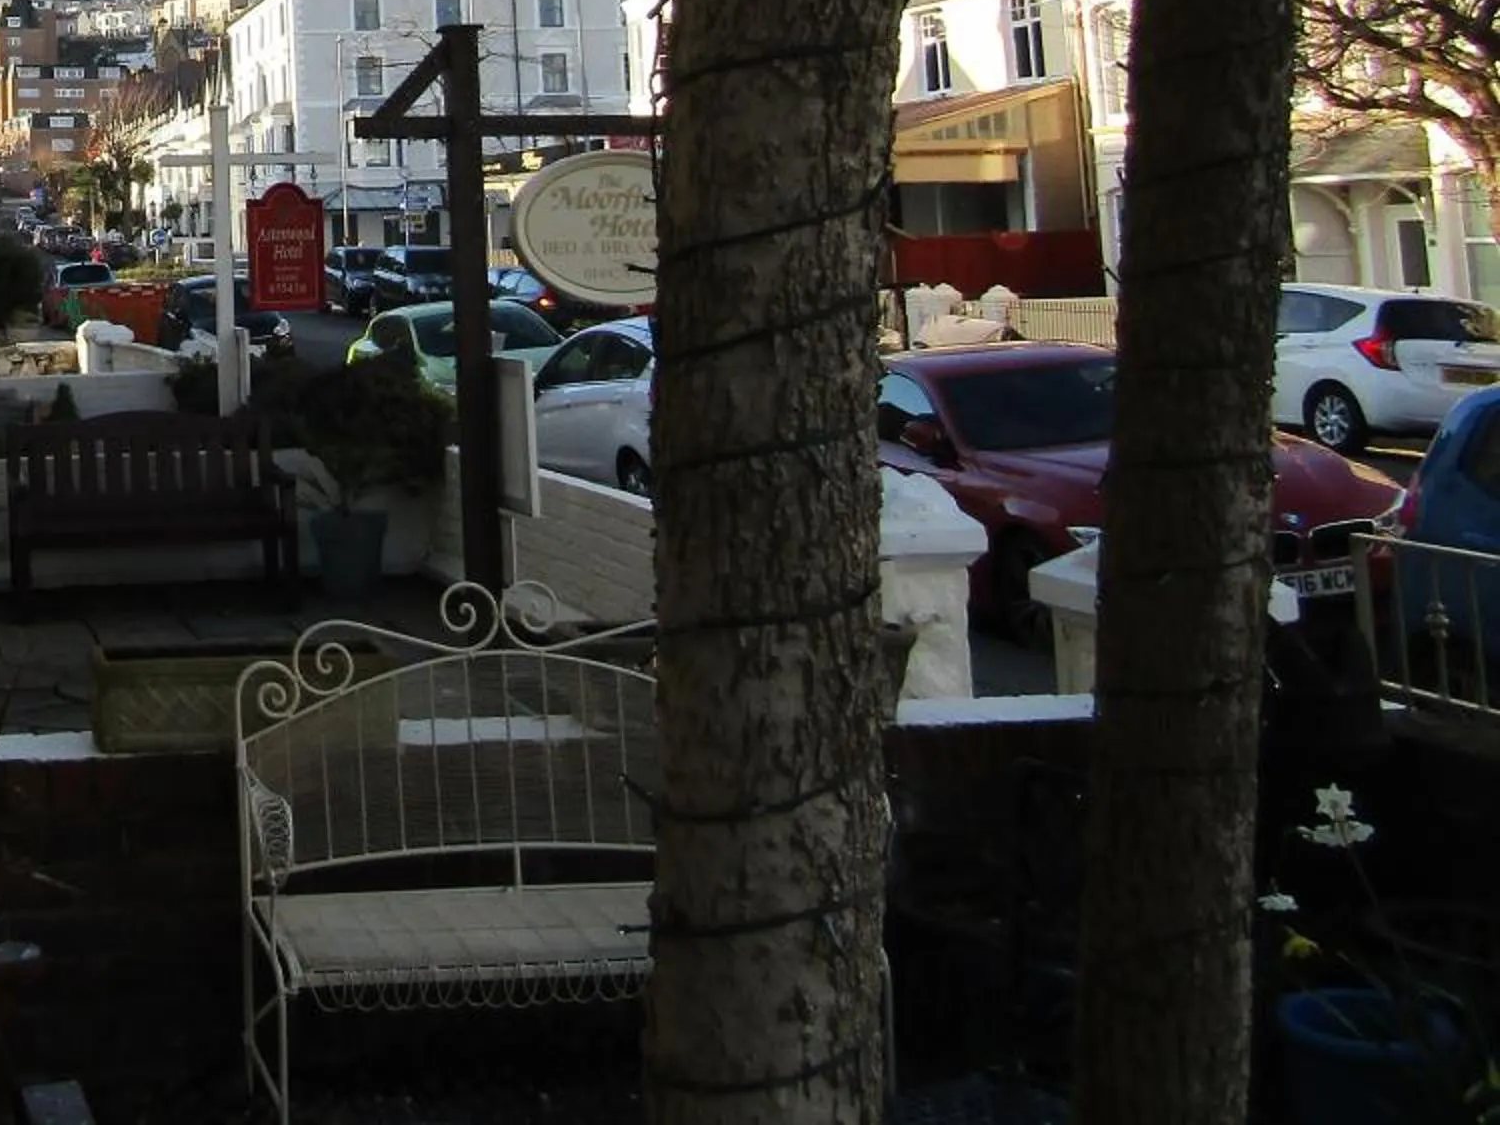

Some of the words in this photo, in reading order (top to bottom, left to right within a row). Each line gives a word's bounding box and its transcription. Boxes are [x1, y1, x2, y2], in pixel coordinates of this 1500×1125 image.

[551, 184, 652, 212] Moorfi
[588, 214, 656, 239] Hote
[542, 239, 577, 255] BED
